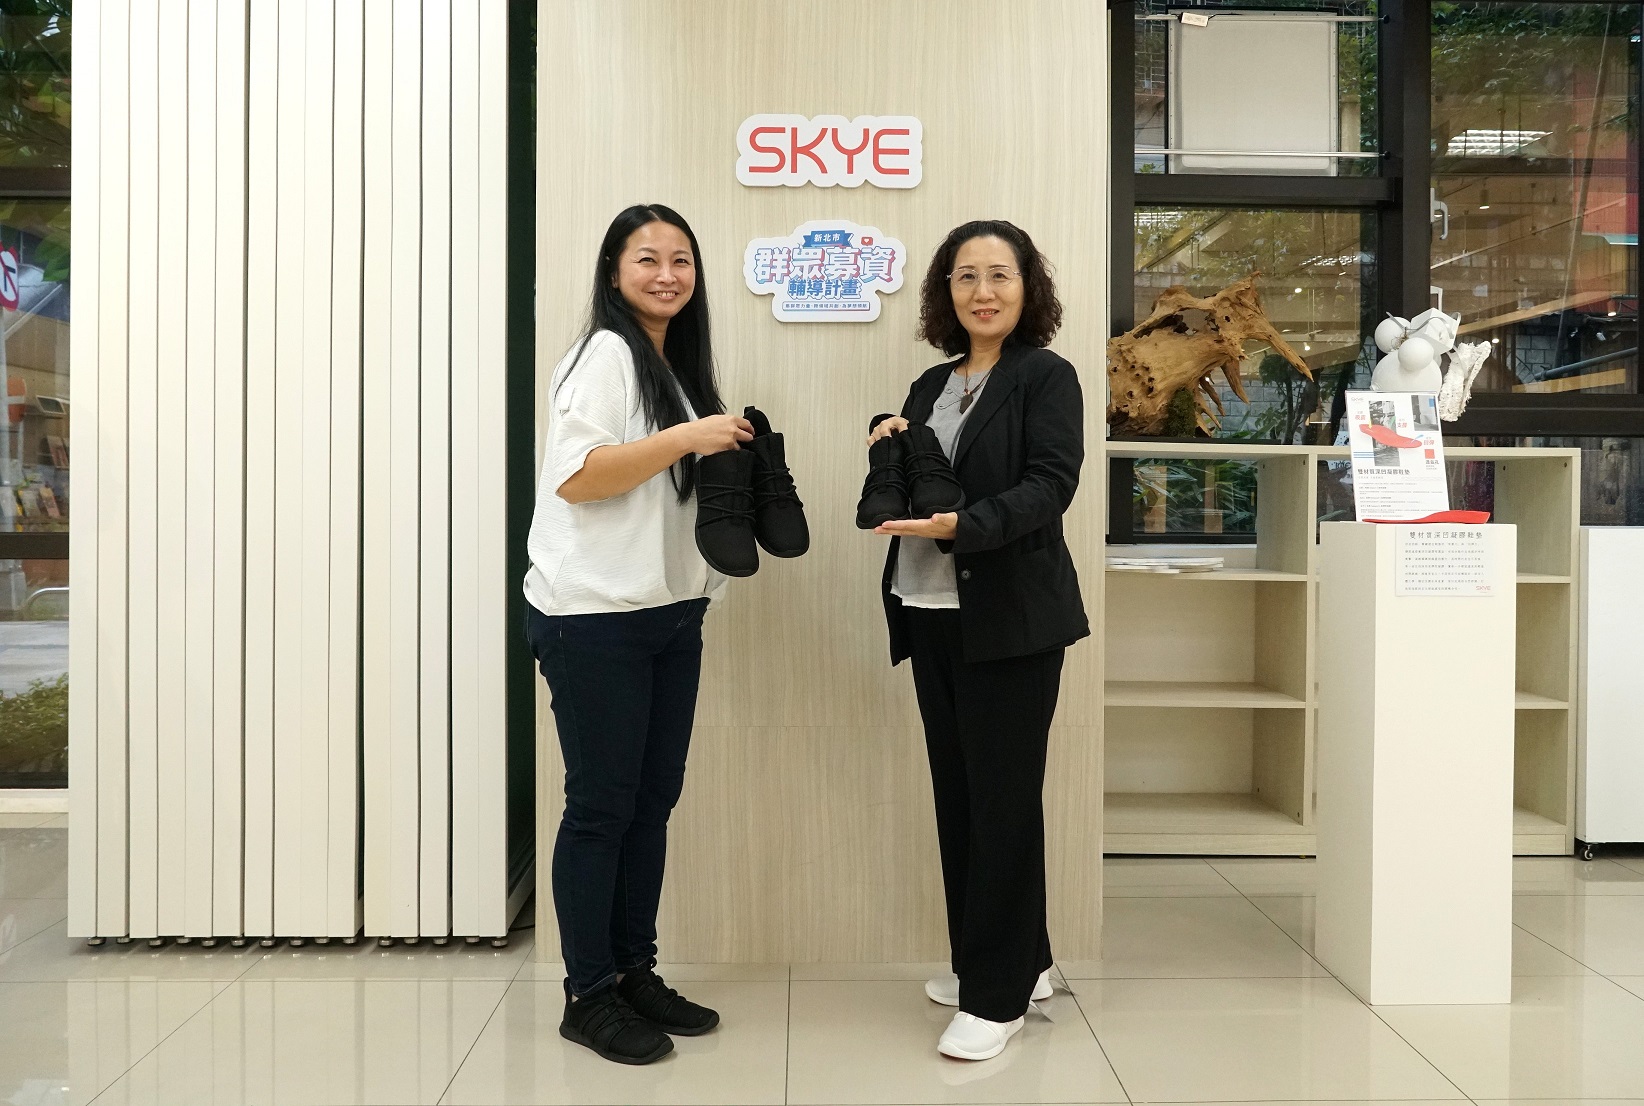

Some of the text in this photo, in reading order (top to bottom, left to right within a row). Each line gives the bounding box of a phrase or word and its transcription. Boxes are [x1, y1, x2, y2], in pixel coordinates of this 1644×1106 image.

[748, 126, 910, 176] SKYE
[813, 233, 841, 242] 新北市
[754, 246, 896, 284] 群眾募資
[788, 278, 862, 298] 輔導計畫
